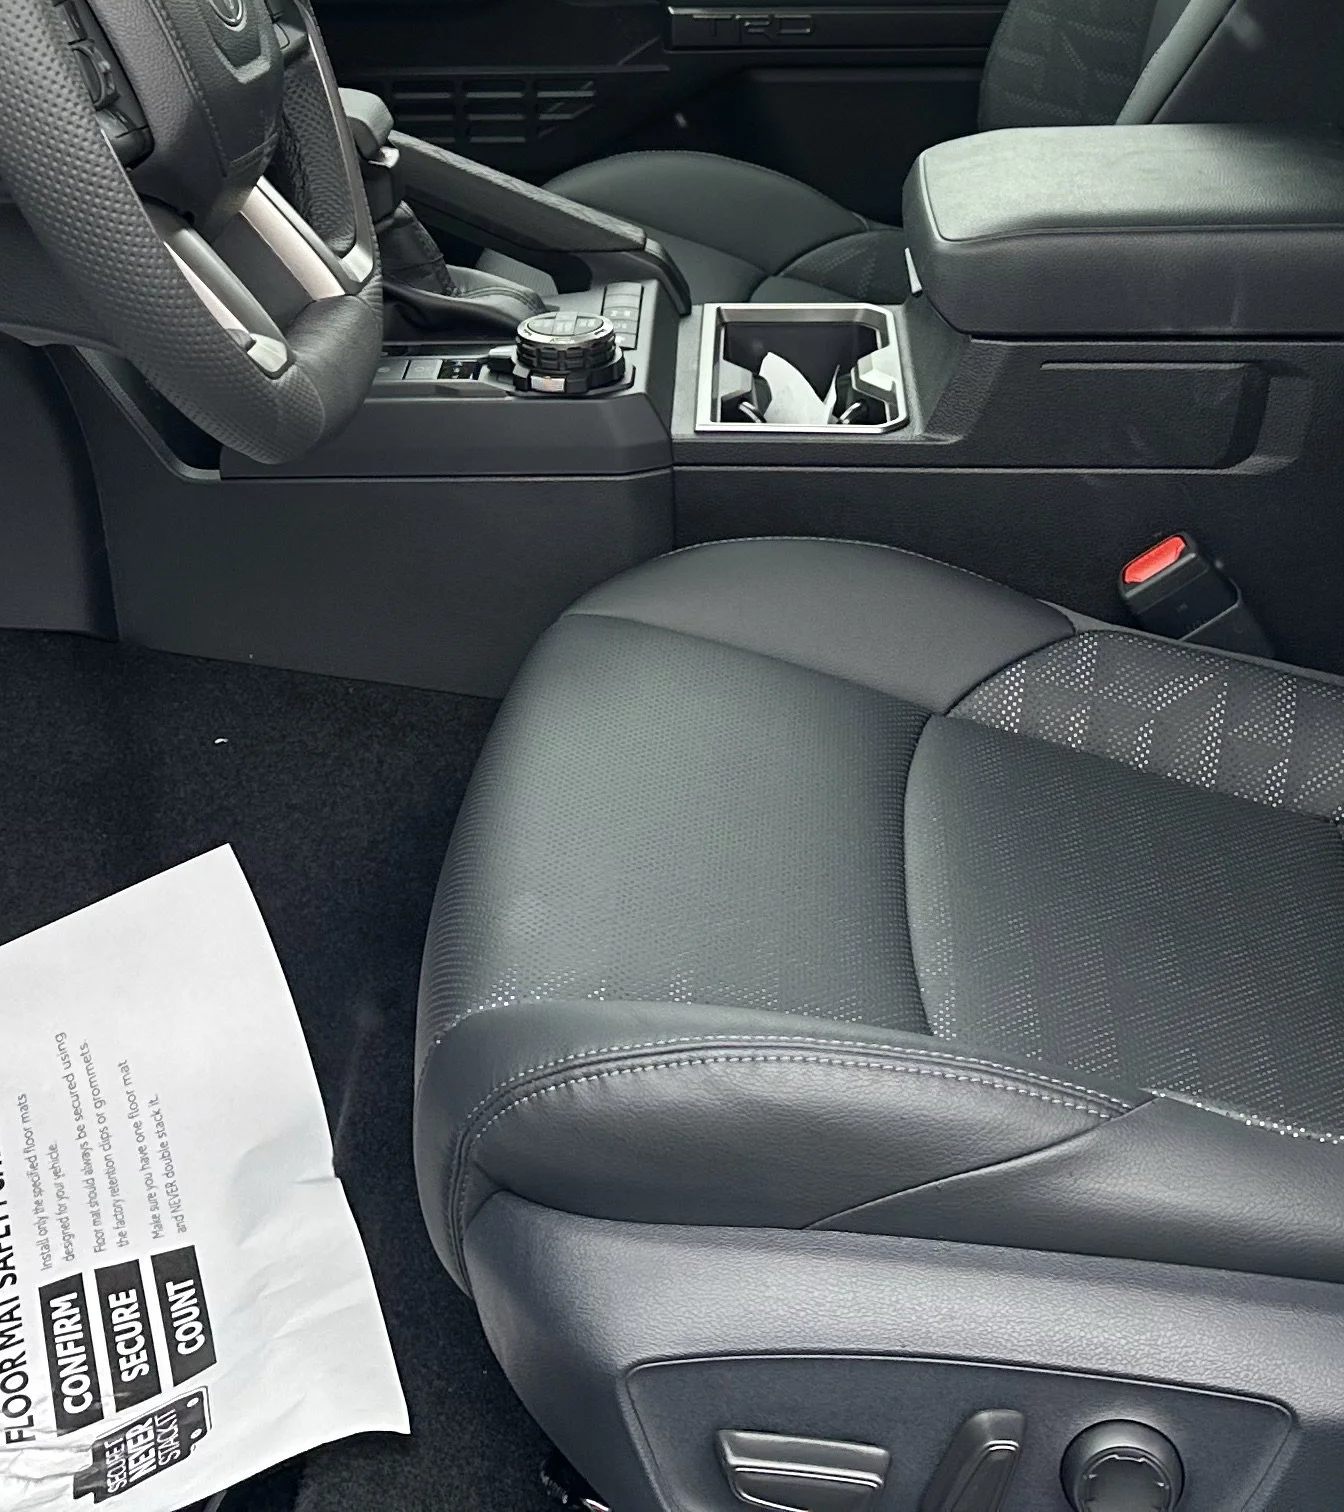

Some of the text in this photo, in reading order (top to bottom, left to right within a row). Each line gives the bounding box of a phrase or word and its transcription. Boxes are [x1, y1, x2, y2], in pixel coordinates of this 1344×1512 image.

[95, 1112, 107, 1125] or
[98, 1125, 113, 1153] clips
[150, 1107, 168, 1140] stack
[54, 1031, 107, 1254] Floor mat should always be secured using
[117, 1059, 165, 1240] Make sure you have one floor mat
[156, 1140, 176, 1179] double
[16, 1093, 53, 1272] Install only the specified floor mats
[53, 1181, 70, 1202] your
[103, 1153, 121, 1198] retention
[164, 1179, 183, 1214] NEVER
[54, 1202, 68, 1216] for
[112, 1198, 126, 1230] factory
[170, 1213, 188, 1234] and
[55, 1215, 76, 1262] designed
[115, 1230, 130, 1248] the
[108, 1288, 150, 1383] SECURE
[165, 1278, 206, 1356] COUNT
[49, 1291, 94, 1414] CONFIRM
[126, 1418, 156, 1482] NEVER
[157, 1420, 180, 1465] STACK
